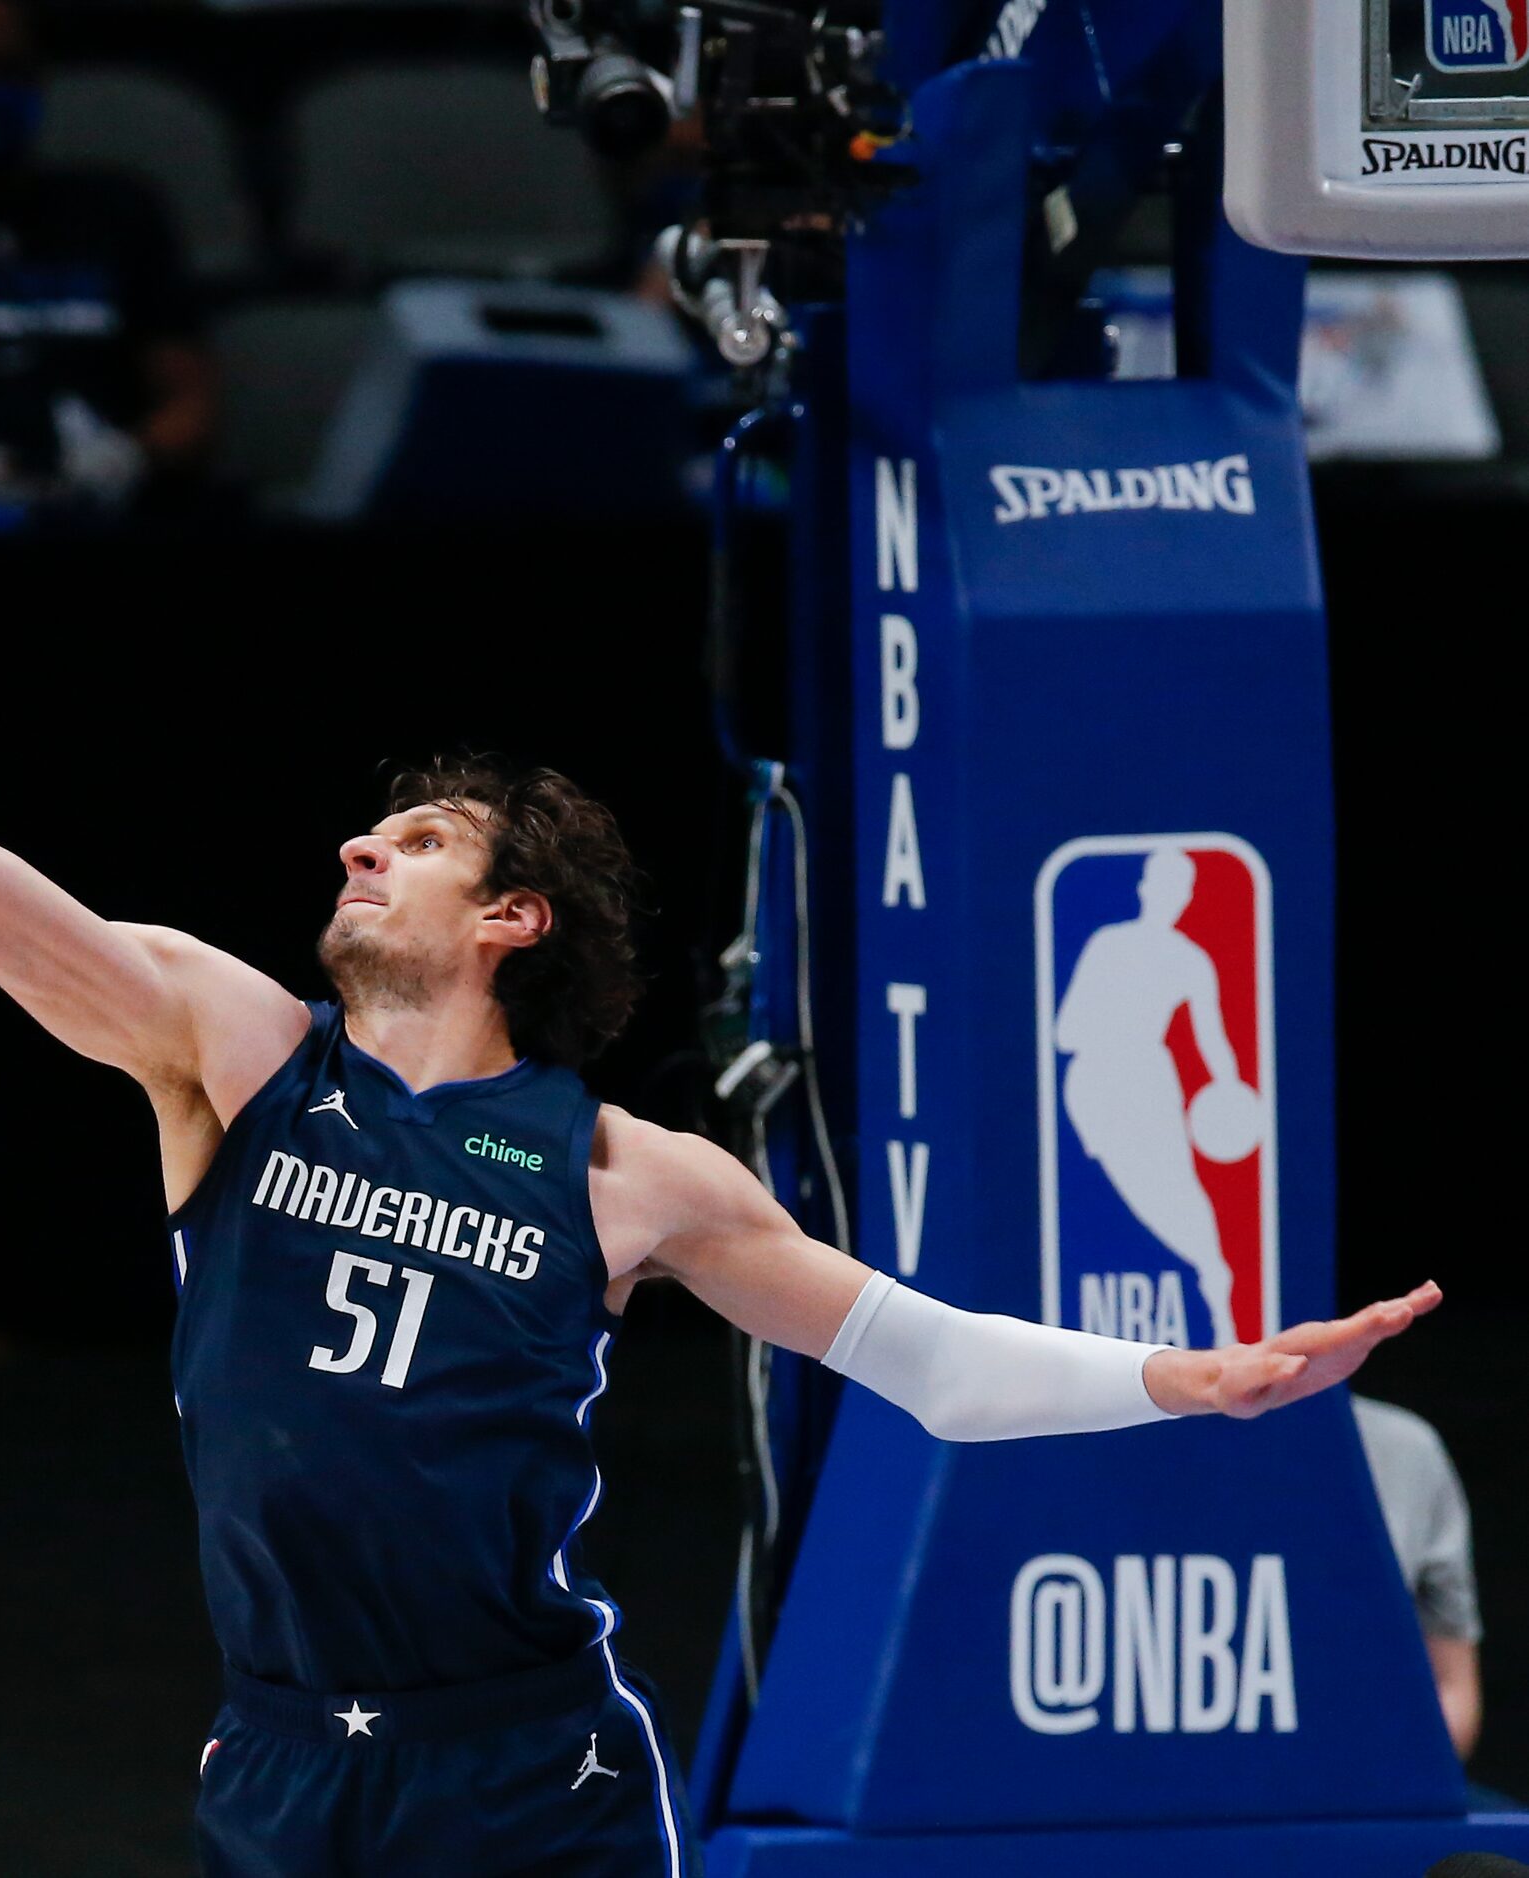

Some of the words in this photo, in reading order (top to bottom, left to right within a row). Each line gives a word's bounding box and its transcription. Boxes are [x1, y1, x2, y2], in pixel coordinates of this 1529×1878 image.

[1442, 14, 1493, 55] NBA
[1361, 137, 1526, 176] SPALDING
[989, 454, 1256, 525] SPALDING
[874, 456, 927, 910] NBA
[464, 1133, 544, 1173] chime
[886, 982, 930, 1277] TV
[251, 1150, 546, 1282] MAVERICKS
[307, 1250, 436, 1390] 51
[1079, 1270, 1189, 1349] NBA
[1009, 1552, 1299, 1736] @NBA
